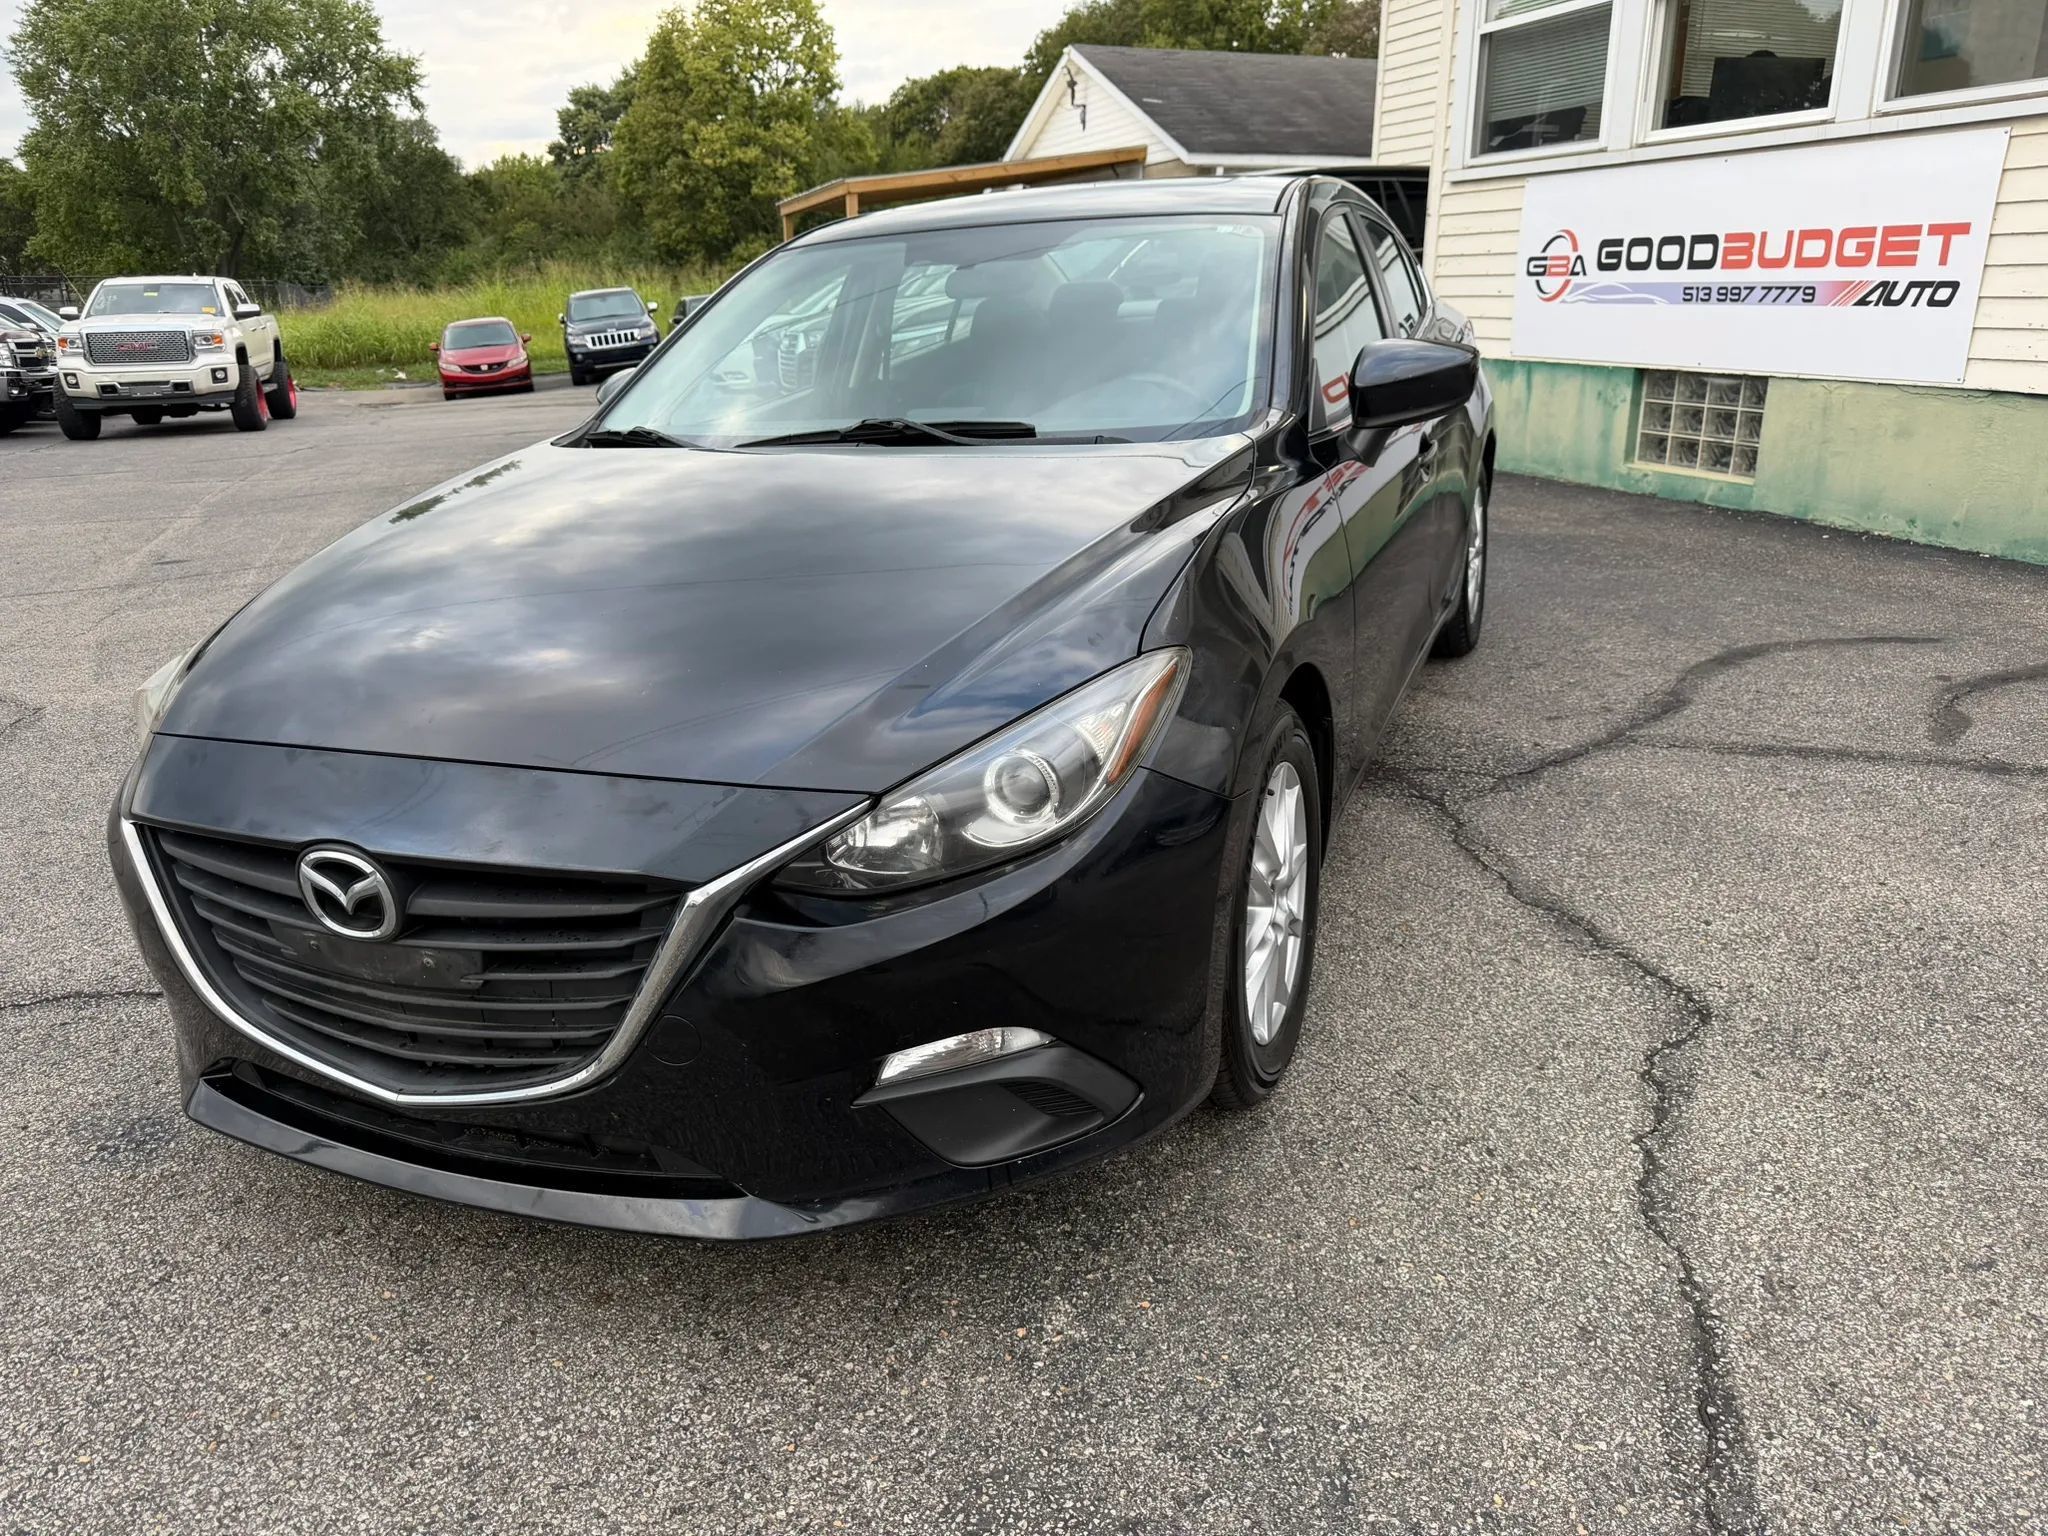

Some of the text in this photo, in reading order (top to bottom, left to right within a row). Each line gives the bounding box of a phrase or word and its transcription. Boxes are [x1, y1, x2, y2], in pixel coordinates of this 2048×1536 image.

[1526, 255, 1587, 276] GBA
[1682, 286, 1816, 303] 513 997 7779
[1851, 280, 1960, 307] AUTO
[116, 342, 157, 352] GMC
